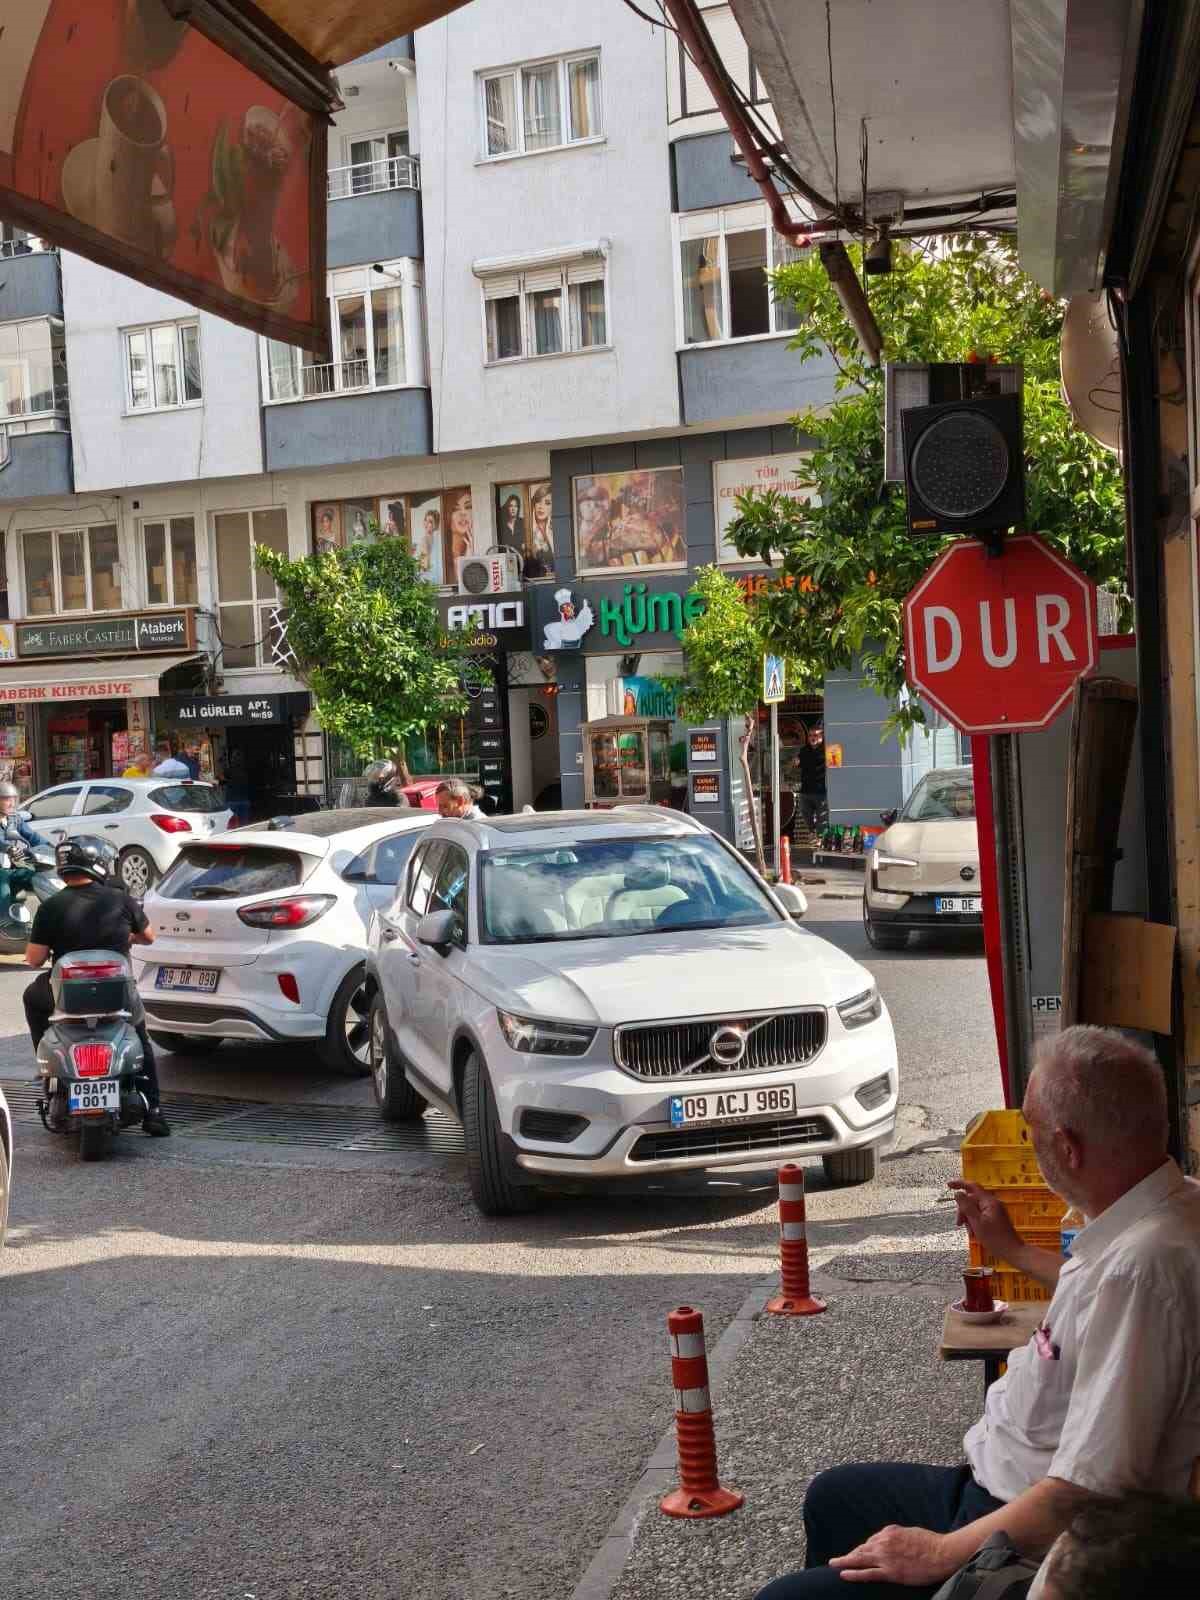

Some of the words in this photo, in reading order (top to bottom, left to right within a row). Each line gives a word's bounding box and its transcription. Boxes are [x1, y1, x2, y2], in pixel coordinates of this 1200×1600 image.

[140, 620, 184, 636] Ataberk
[923, 594, 1077, 674] DUR
[179, 705, 196, 718] ALİ
[200, 704, 243, 718] GÜRLER
[248, 700, 270, 711] APT.
[941, 899, 954, 911] 09
[961, 899, 974, 911] DE
[73, 1082, 117, 1096] 09APM
[82, 1096, 108, 1108] 001
[684, 1098, 708, 1119] 09
[716, 1092, 749, 1116] ACJ
[756, 1088, 791, 1112] 986
